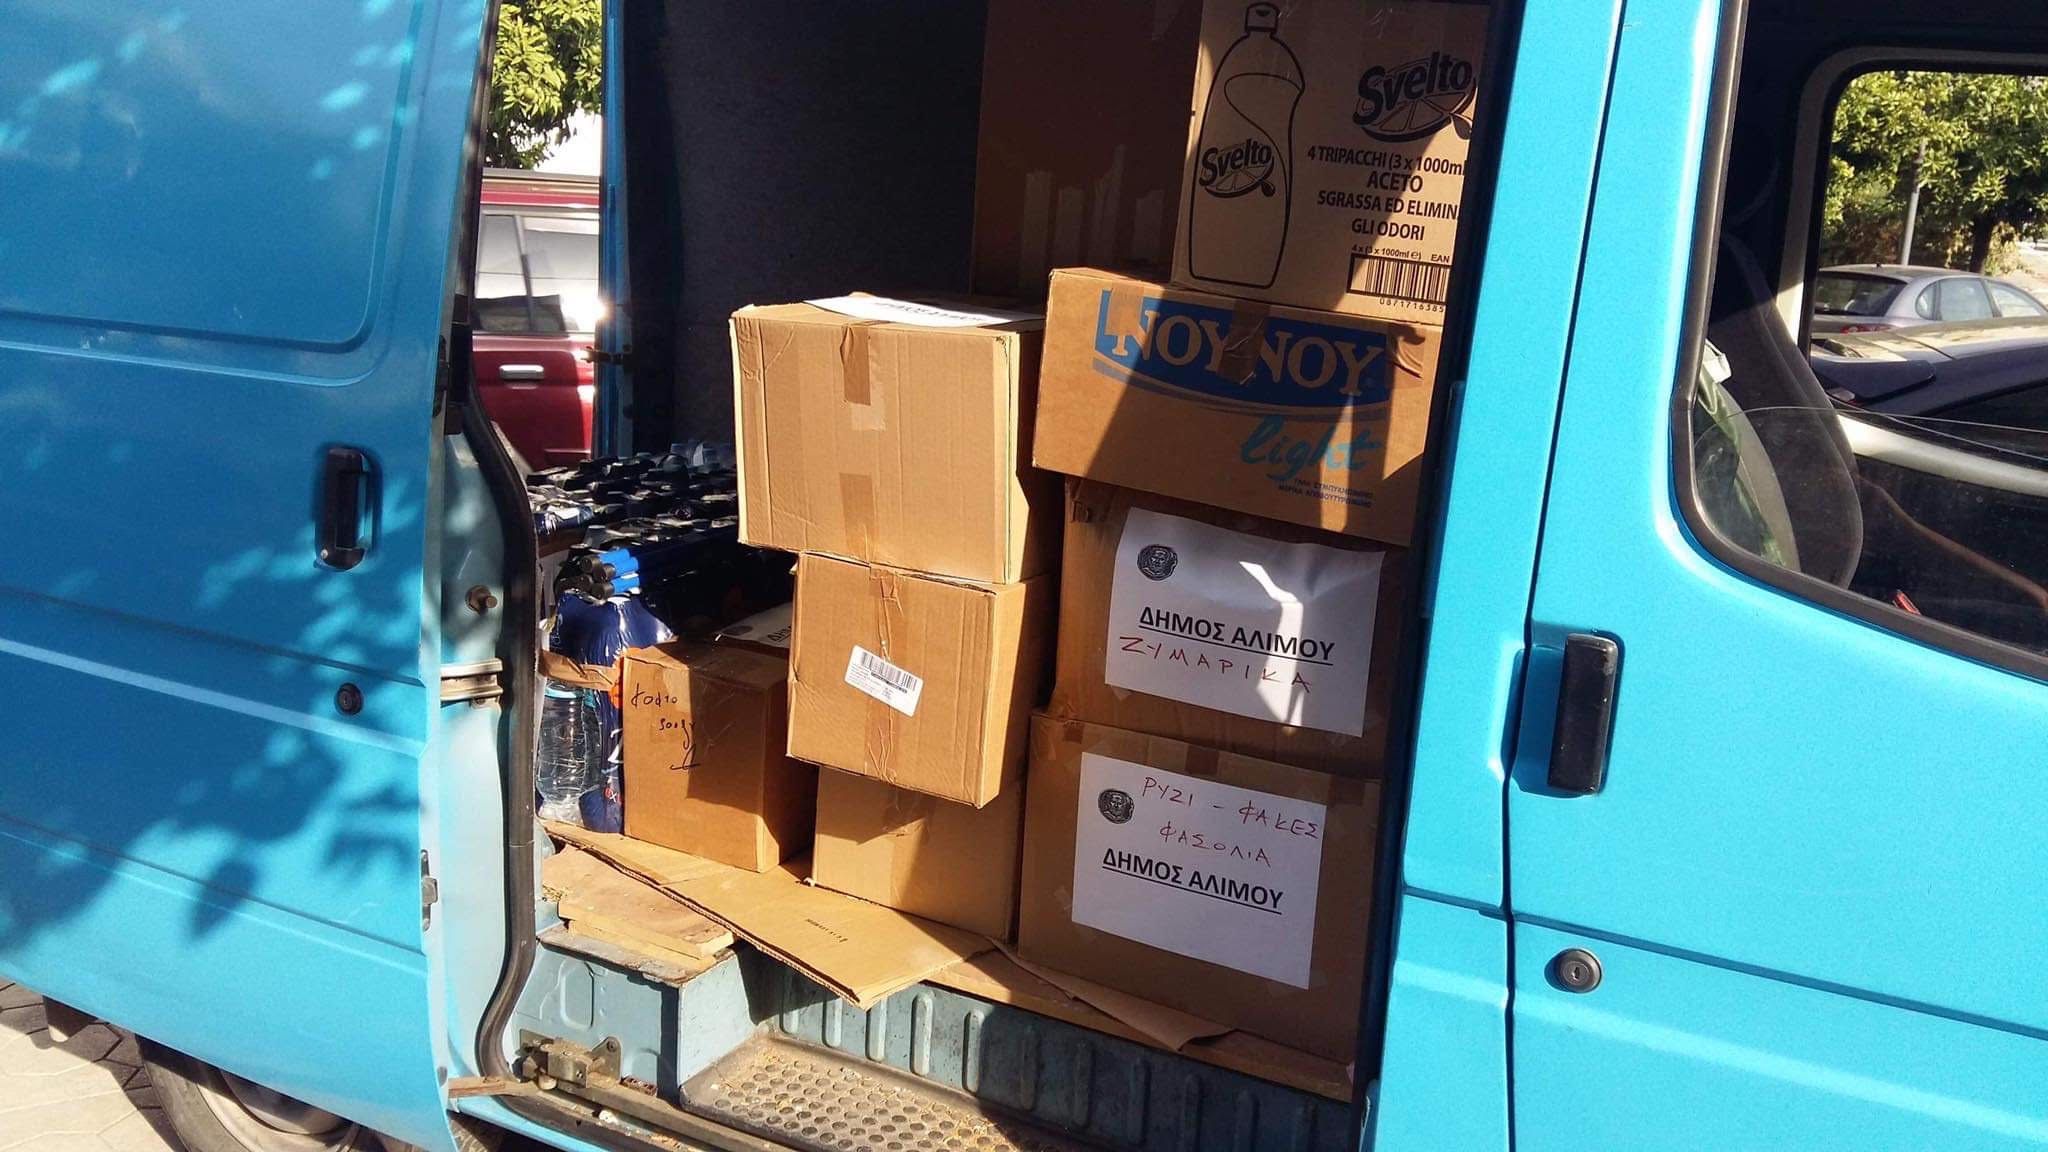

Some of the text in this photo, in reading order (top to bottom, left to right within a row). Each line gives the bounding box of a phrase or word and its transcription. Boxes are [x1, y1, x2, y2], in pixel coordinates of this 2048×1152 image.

[1353, 52, 1473, 125] Svelto
[1199, 139, 1272, 186] Svelto
[1307, 146, 1315, 160] 4
[1318, 146, 1387, 167] TRIPACCHI
[1367, 171, 1423, 193] ACETO
[1317, 190, 1458, 220] SGRASSA ED ELIMIN
[1352, 218, 1425, 241] GLI ODORI
[1382, 248, 1409, 259] 1000ml
[1430, 254, 1450, 264] EAN
[1240, 415, 1382, 481] light
[1140, 606, 1335, 661] ΔΗΜΟΣ ΑΛΙΜΟΥ
[1102, 848, 1284, 909] ΔΗΜΟΣ ΑΛΙΜΟΥ
